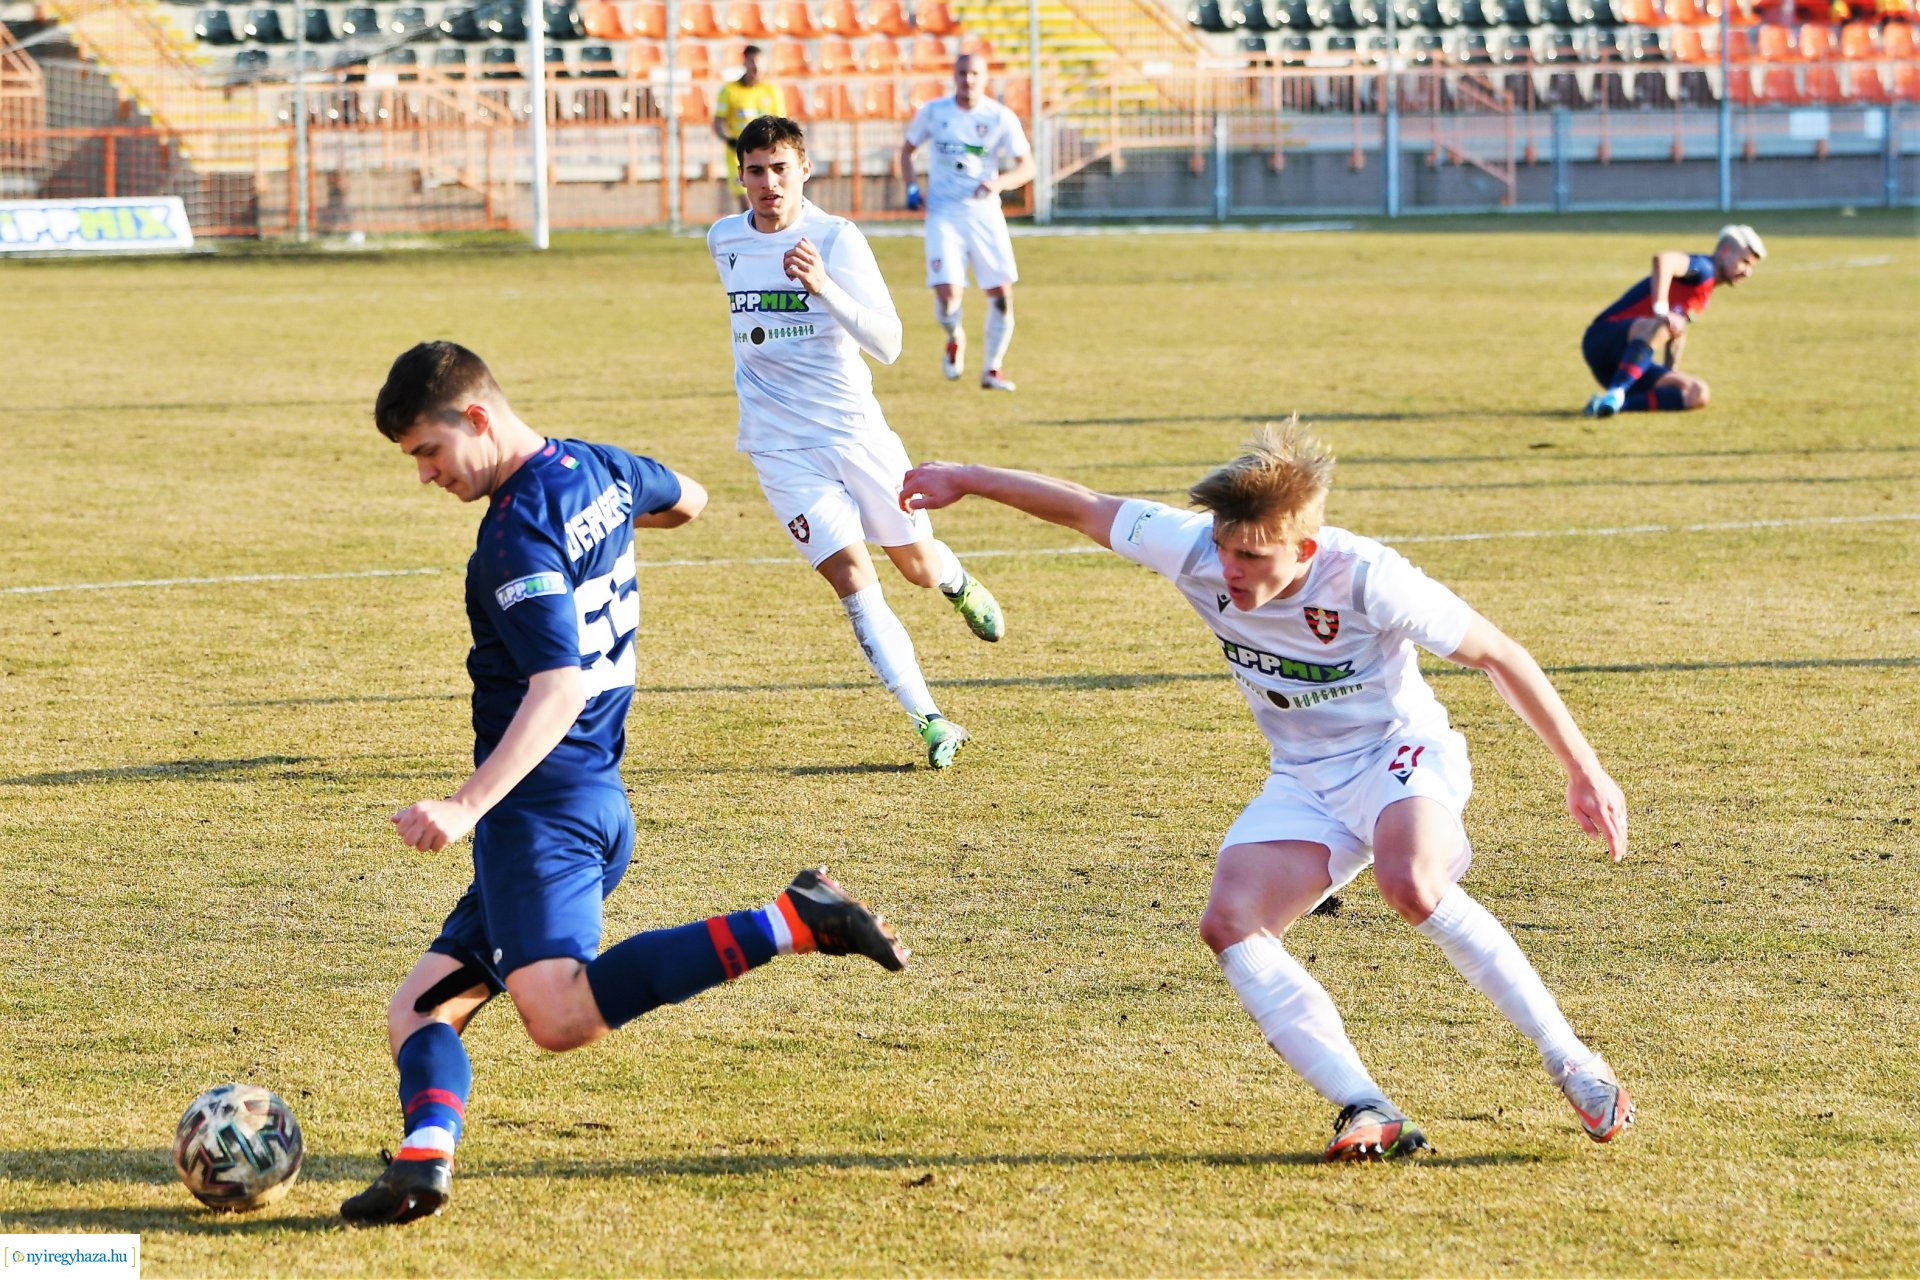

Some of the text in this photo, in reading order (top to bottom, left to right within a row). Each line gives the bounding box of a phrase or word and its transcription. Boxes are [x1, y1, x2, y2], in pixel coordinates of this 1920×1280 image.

[0, 206, 176, 243] iPPMIX
[728, 291, 809, 312] iPPMIX
[1221, 640, 1355, 683] iPPMIX
